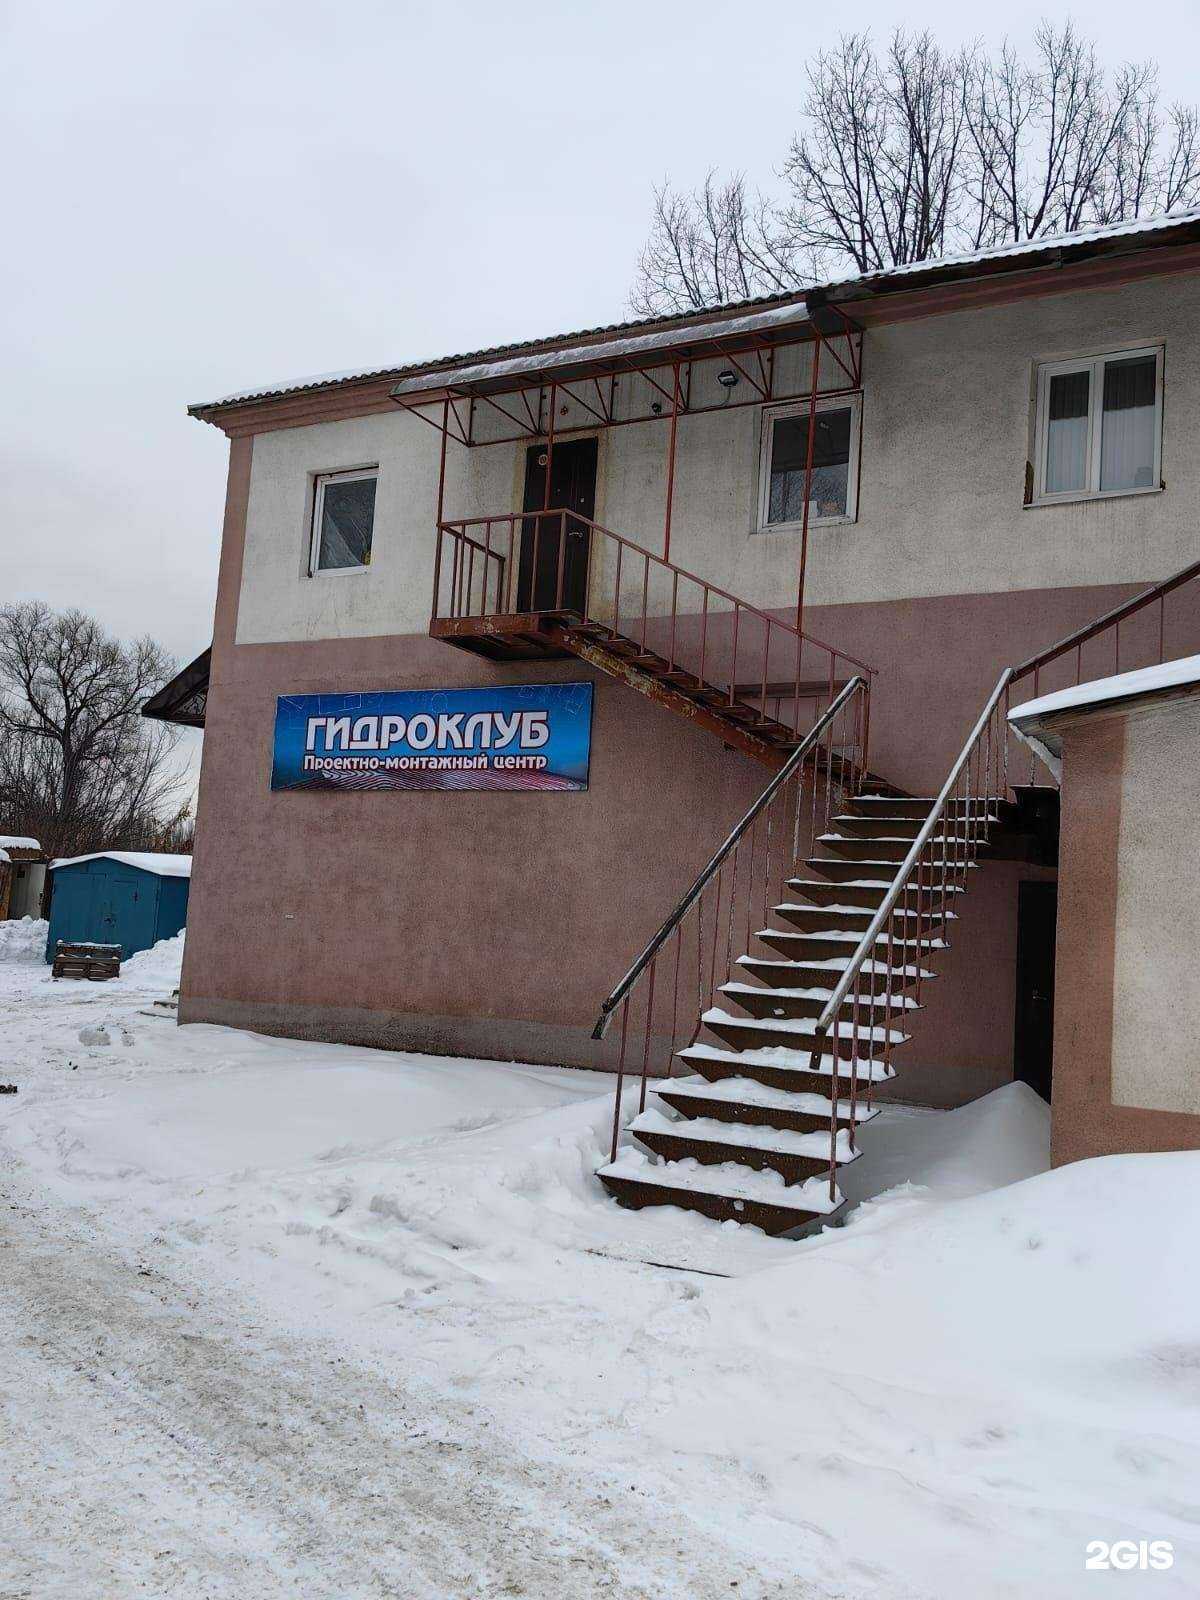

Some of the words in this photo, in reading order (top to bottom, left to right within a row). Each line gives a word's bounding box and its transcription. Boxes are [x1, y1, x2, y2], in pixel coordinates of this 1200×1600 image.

[305, 710, 550, 752] ГИДРОКЛУБ
[303, 753, 488, 771] Проектно-монтажный
[493, 753, 548, 770] центр
